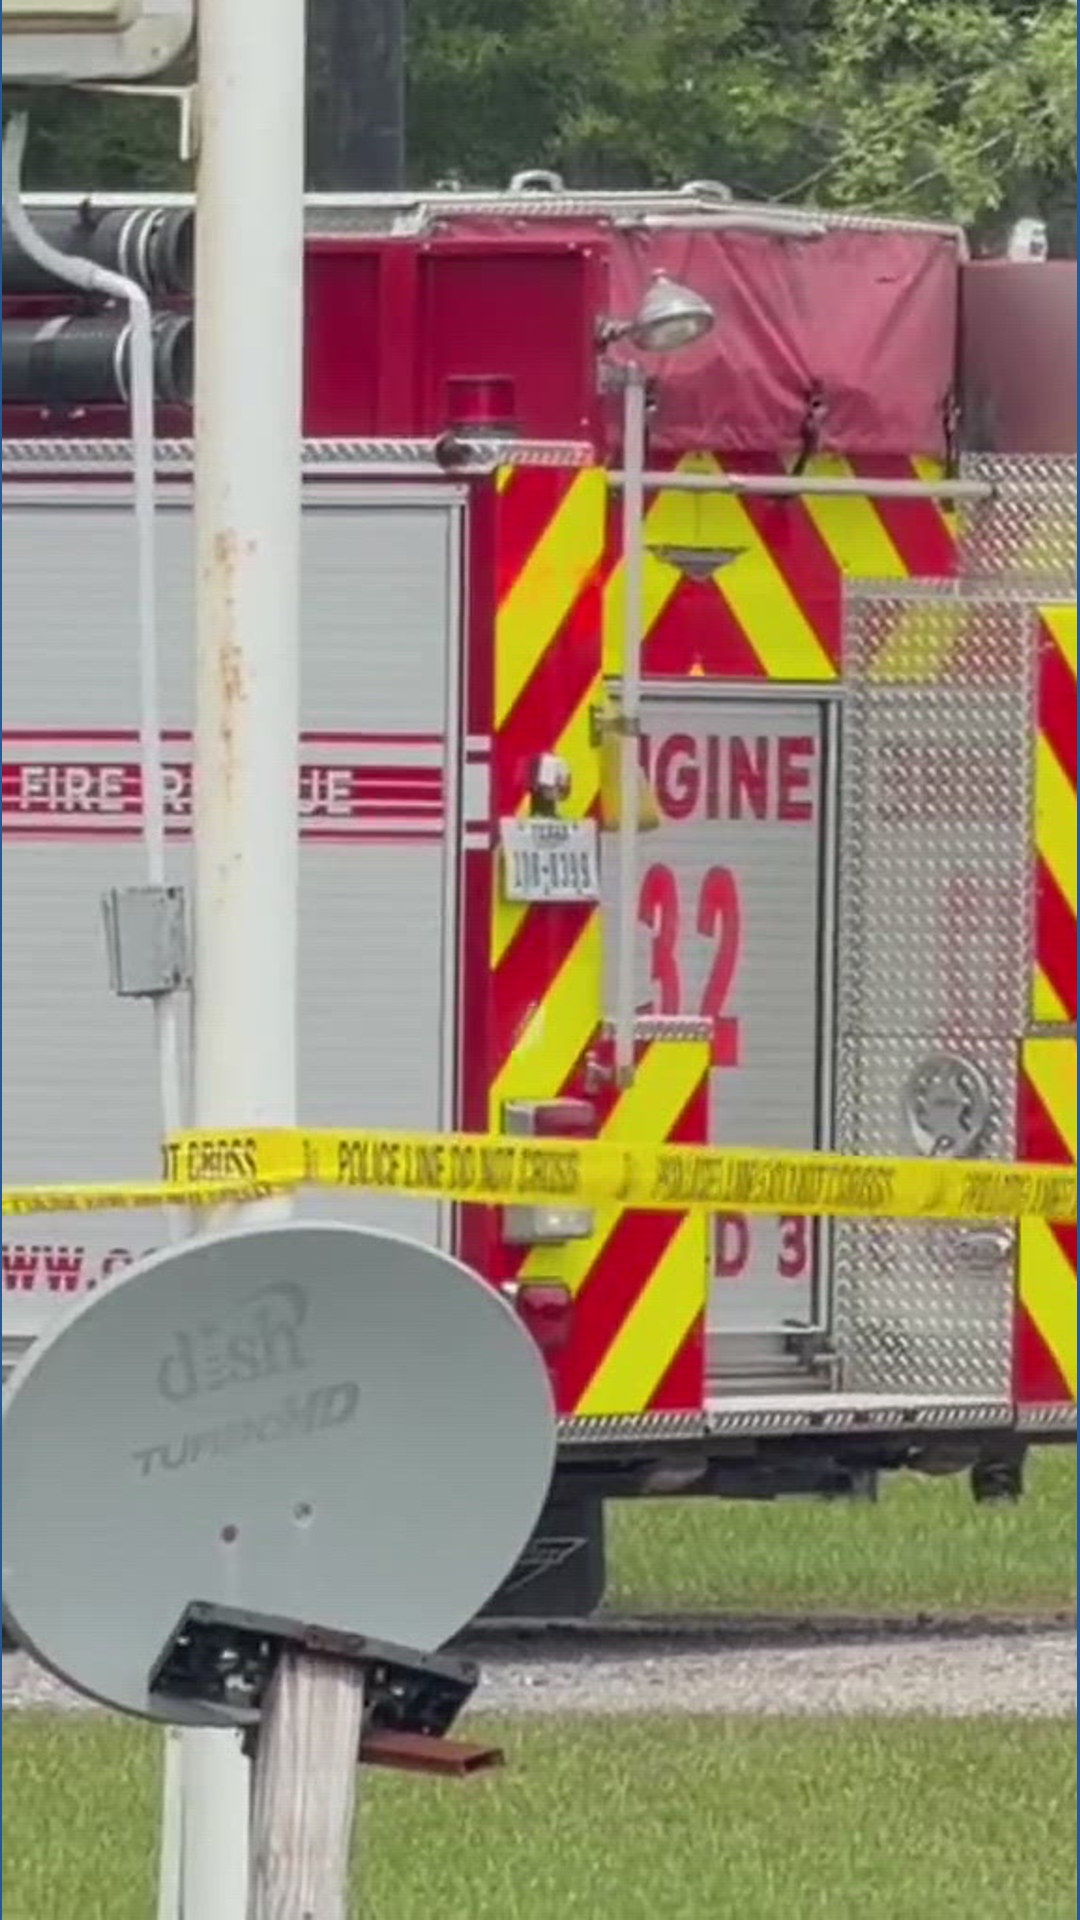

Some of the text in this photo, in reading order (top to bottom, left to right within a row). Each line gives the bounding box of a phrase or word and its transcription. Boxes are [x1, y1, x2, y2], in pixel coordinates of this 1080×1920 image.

[19, 766, 354, 815] FIRE RUE
[638, 733, 815, 820] GINE
[638, 863, 740, 1067] 32
[187, 1137, 258, 1181] CROSS
[338, 1140, 580, 1193] POLICE LINE DO NOT CROSS
